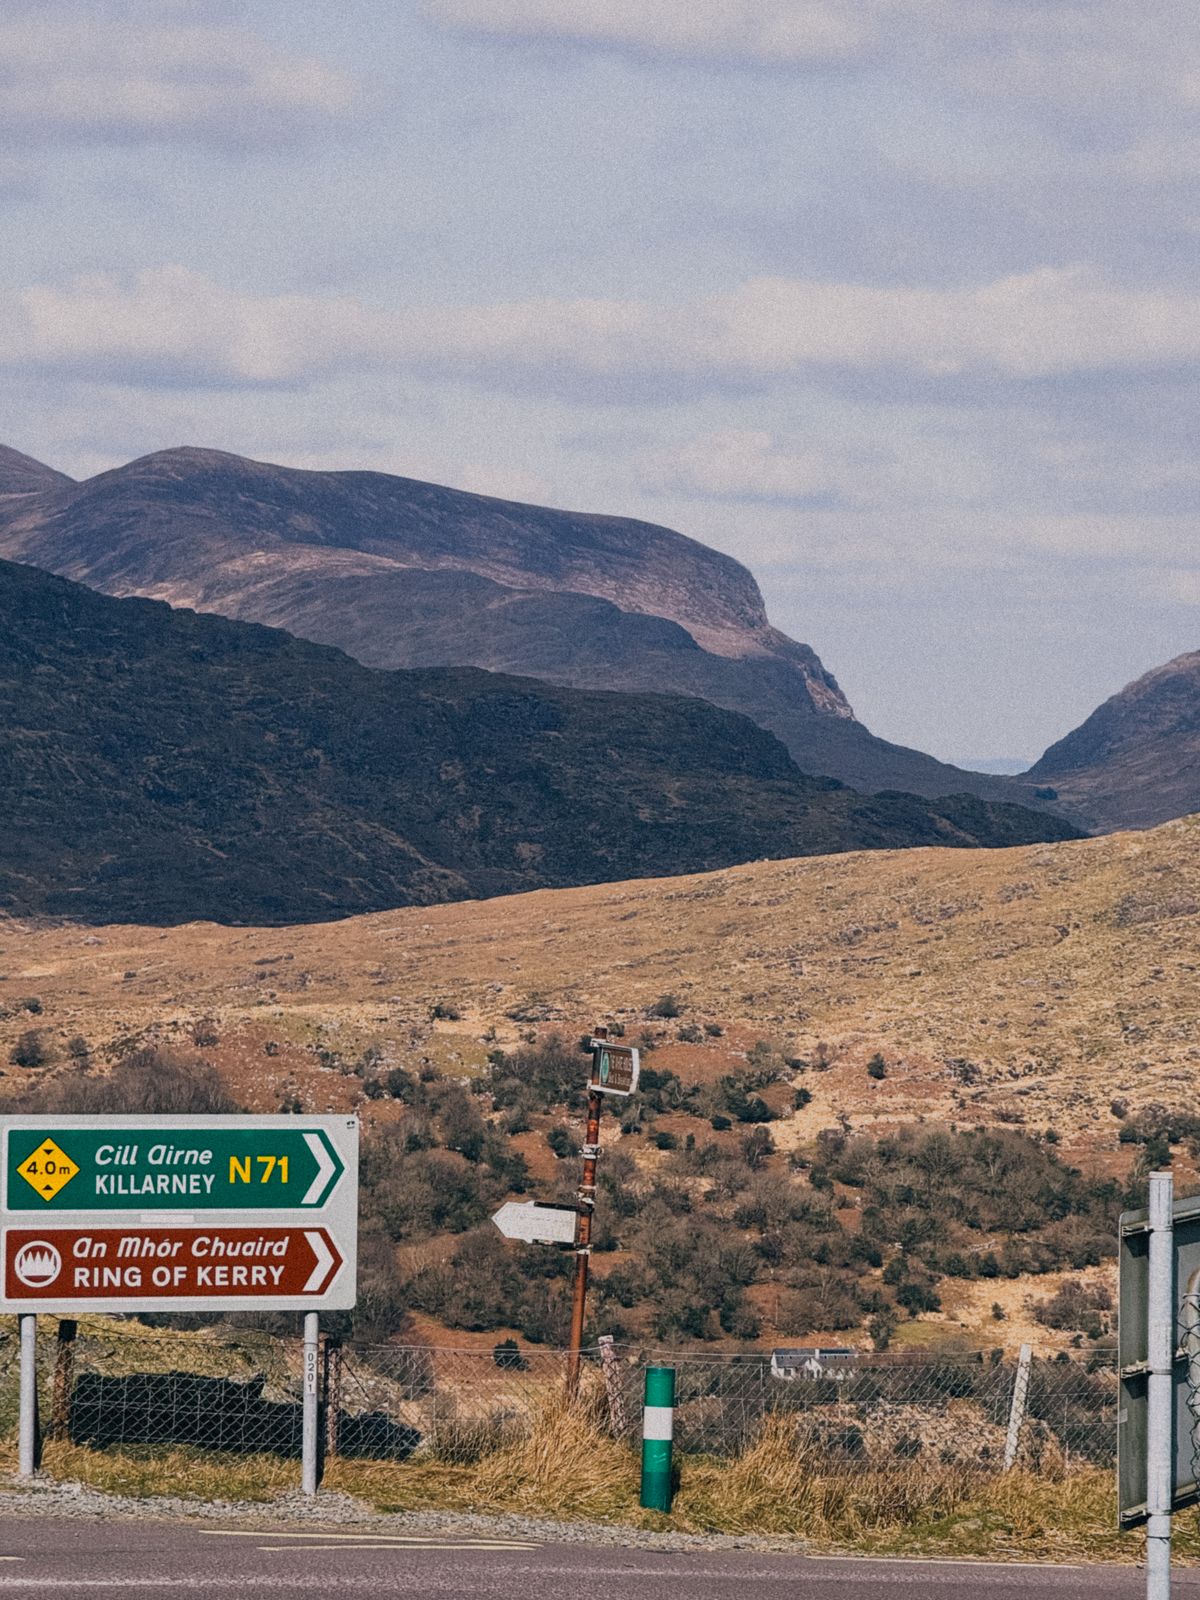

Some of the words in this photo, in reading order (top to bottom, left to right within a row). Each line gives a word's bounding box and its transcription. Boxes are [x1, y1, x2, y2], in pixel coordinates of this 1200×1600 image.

[95, 1145, 137, 1165] Cill
[148, 1145, 213, 1165] Airne
[95, 1174, 215, 1195] KILLARNEY
[73, 1237, 107, 1258] An
[116, 1236, 182, 1258] Mhór
[191, 1236, 290, 1257] Chuaird
[74, 1266, 142, 1288] RING
[151, 1266, 187, 1287] OF
[197, 1265, 285, 1286] KERRY
